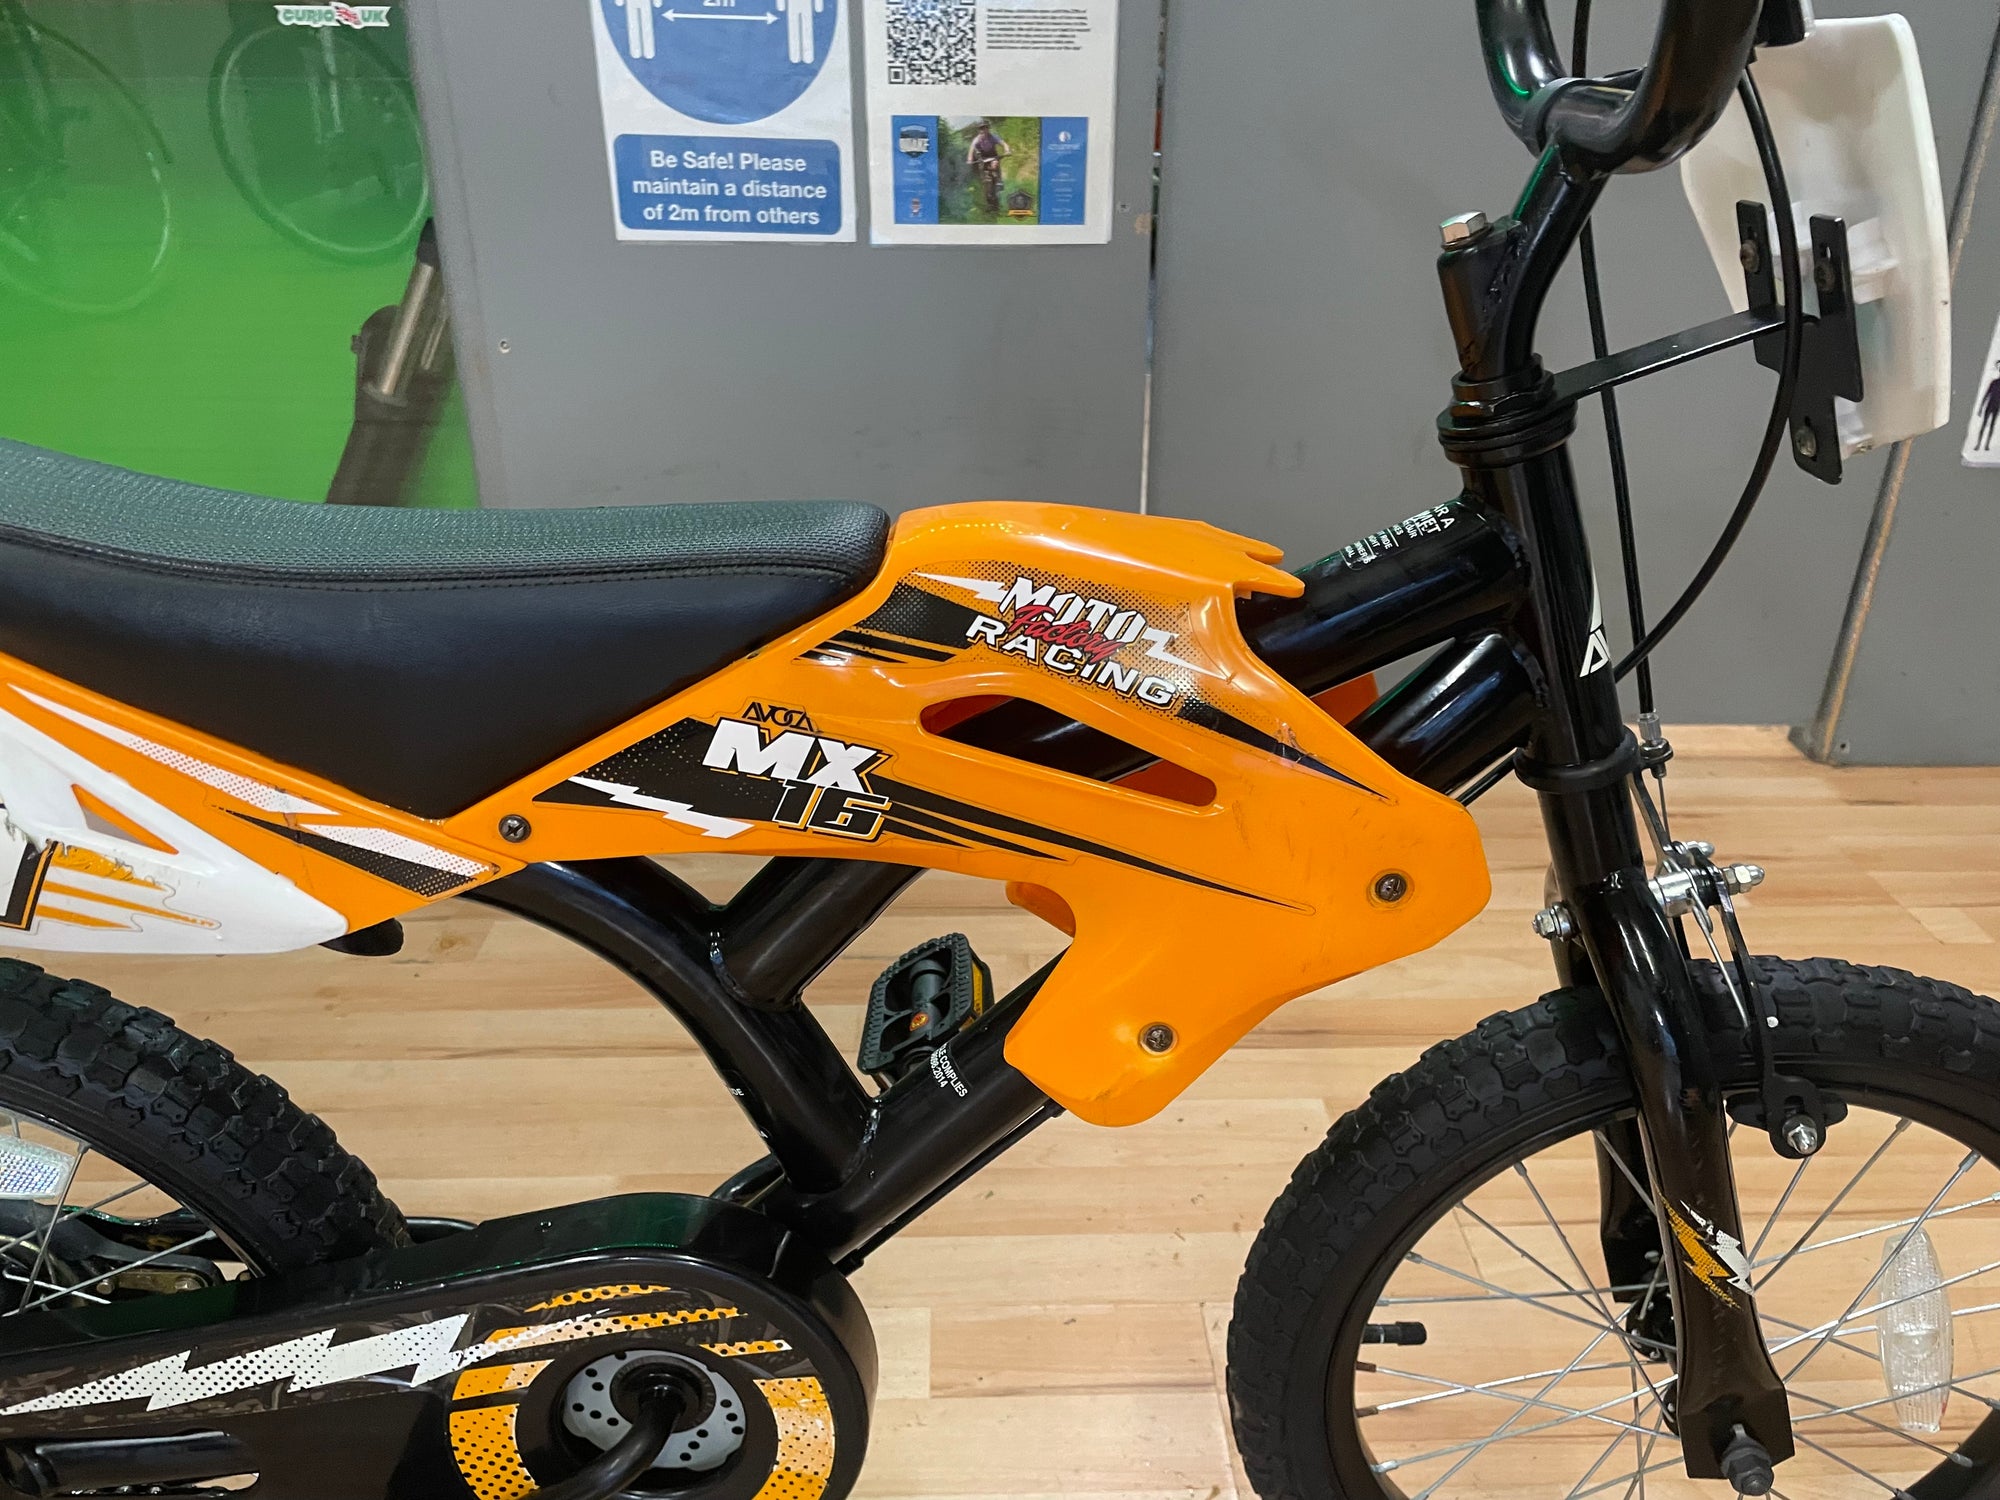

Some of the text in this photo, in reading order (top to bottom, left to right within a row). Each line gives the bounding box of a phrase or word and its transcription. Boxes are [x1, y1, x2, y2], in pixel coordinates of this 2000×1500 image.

[360, 9, 385, 23] UK
[650, 150, 807, 172] Be Safe! Please
[632, 177, 827, 199] maintain a distance
[643, 203, 820, 225] of 2m from others
[1441, 518, 1454, 528] A
[999, 576, 1148, 645] MOTO
[1009, 604, 1127, 664] Factory
[966, 614, 1179, 708] RACING
[742, 702, 820, 732] AVOCA
[701, 717, 885, 796] MX
[772, 779, 892, 841] 16
[940, 1055, 968, 1098] COMPLIES
